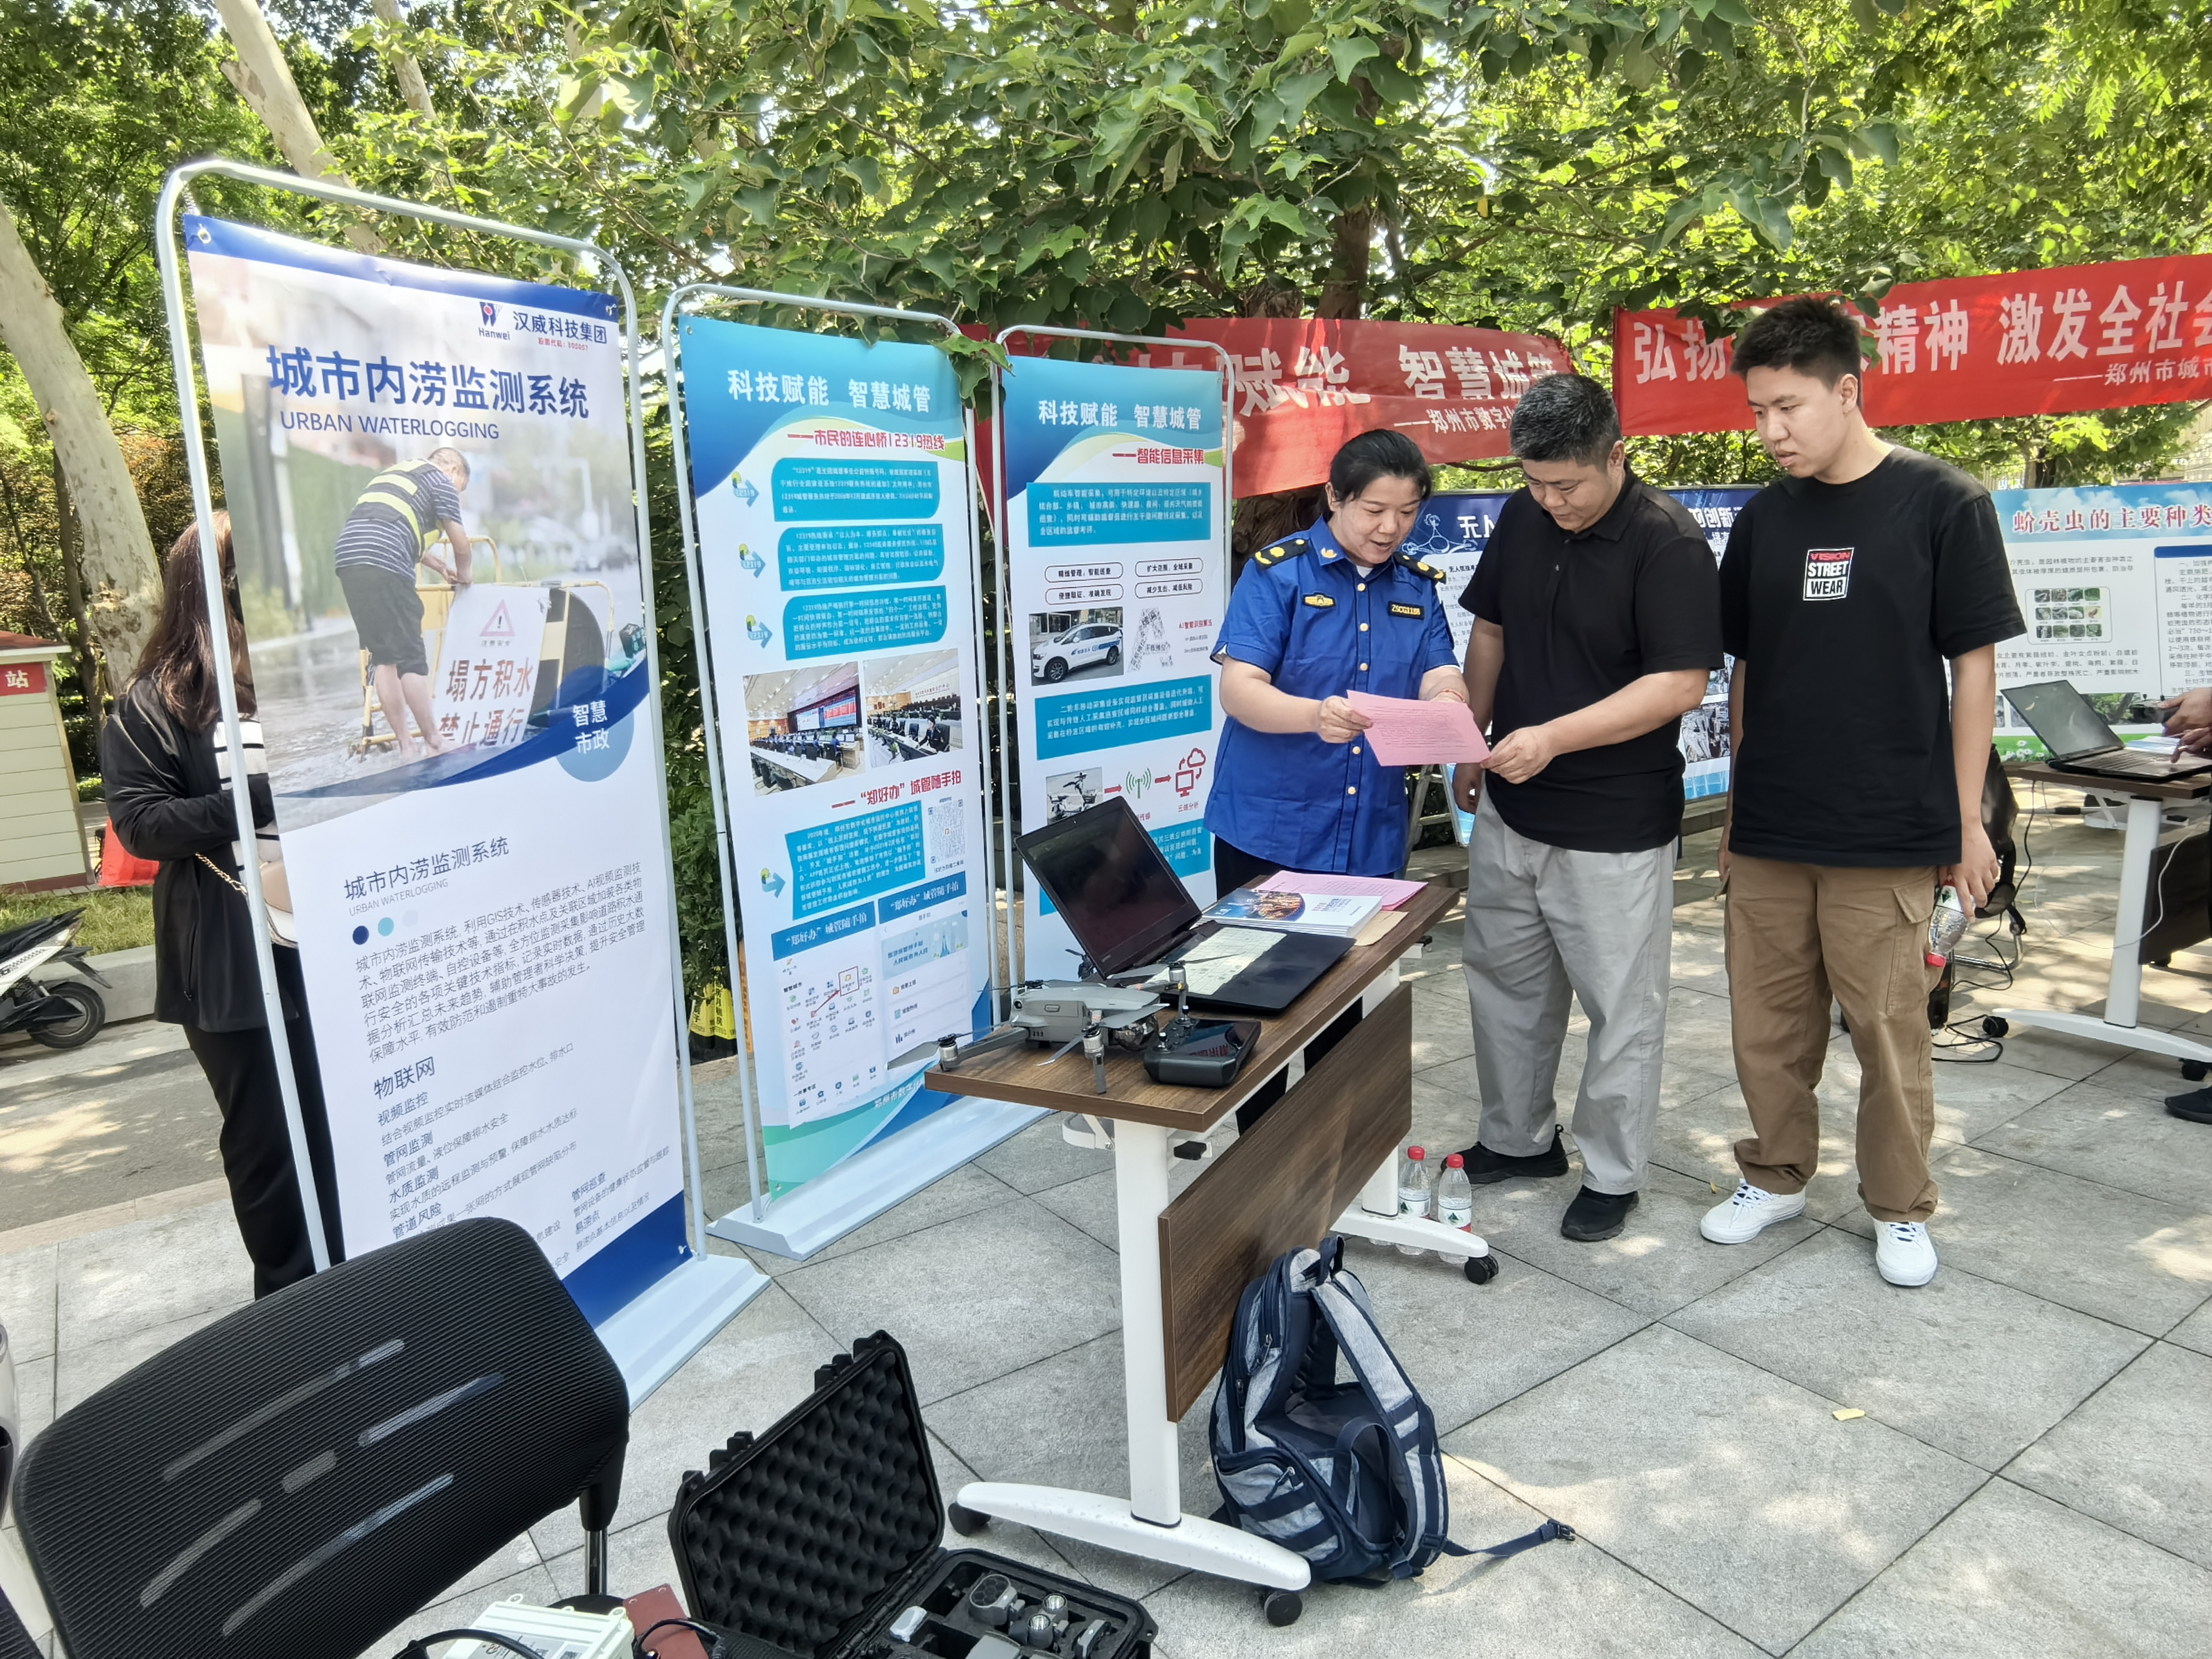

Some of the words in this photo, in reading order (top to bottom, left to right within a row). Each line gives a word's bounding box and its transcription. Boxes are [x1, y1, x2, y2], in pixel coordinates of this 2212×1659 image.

[479, 327, 510, 341] Hanwei
[513, 311, 607, 344] 汉威科技集团
[265, 344, 590, 419] 城市内涝监测系统
[727, 370, 830, 406] 科技赋能
[848, 379, 931, 413] 智慧城管
[280, 410, 353, 432] URBAN
[359, 415, 500, 440] WATERLOGGING
[1038, 399, 1118, 427] 科技赋能
[1134, 404, 1201, 431] 智慧城管
[2013, 504, 2212, 534] 蚧壳虫的主要种类
[1807, 560, 1849, 577] STREET
[1811, 579, 1844, 595] WEAR
[5, 670, 29, 688] 站
[446, 658, 534, 702] 塌方积水
[438, 708, 526, 747] 禁止通行
[572, 700, 607, 728] 智慧
[575, 731, 610, 754] 市政
[910, 770, 962, 795] 城管随手拍
[343, 836, 510, 902] 城市内涝监测系统
[349, 896, 381, 917] URBAN
[380, 878, 449, 907] WATERLOGGING
[923, 881, 959, 900] 城管随手拍
[825, 911, 867, 935] 城管随手拍
[373, 1057, 435, 1100] 物联网
[377, 1092, 429, 1127] 视频监控
[383, 1130, 434, 1167] 管网监测
[389, 1166, 439, 1204] 水质监测
[392, 1202, 442, 1240] 管道风险
